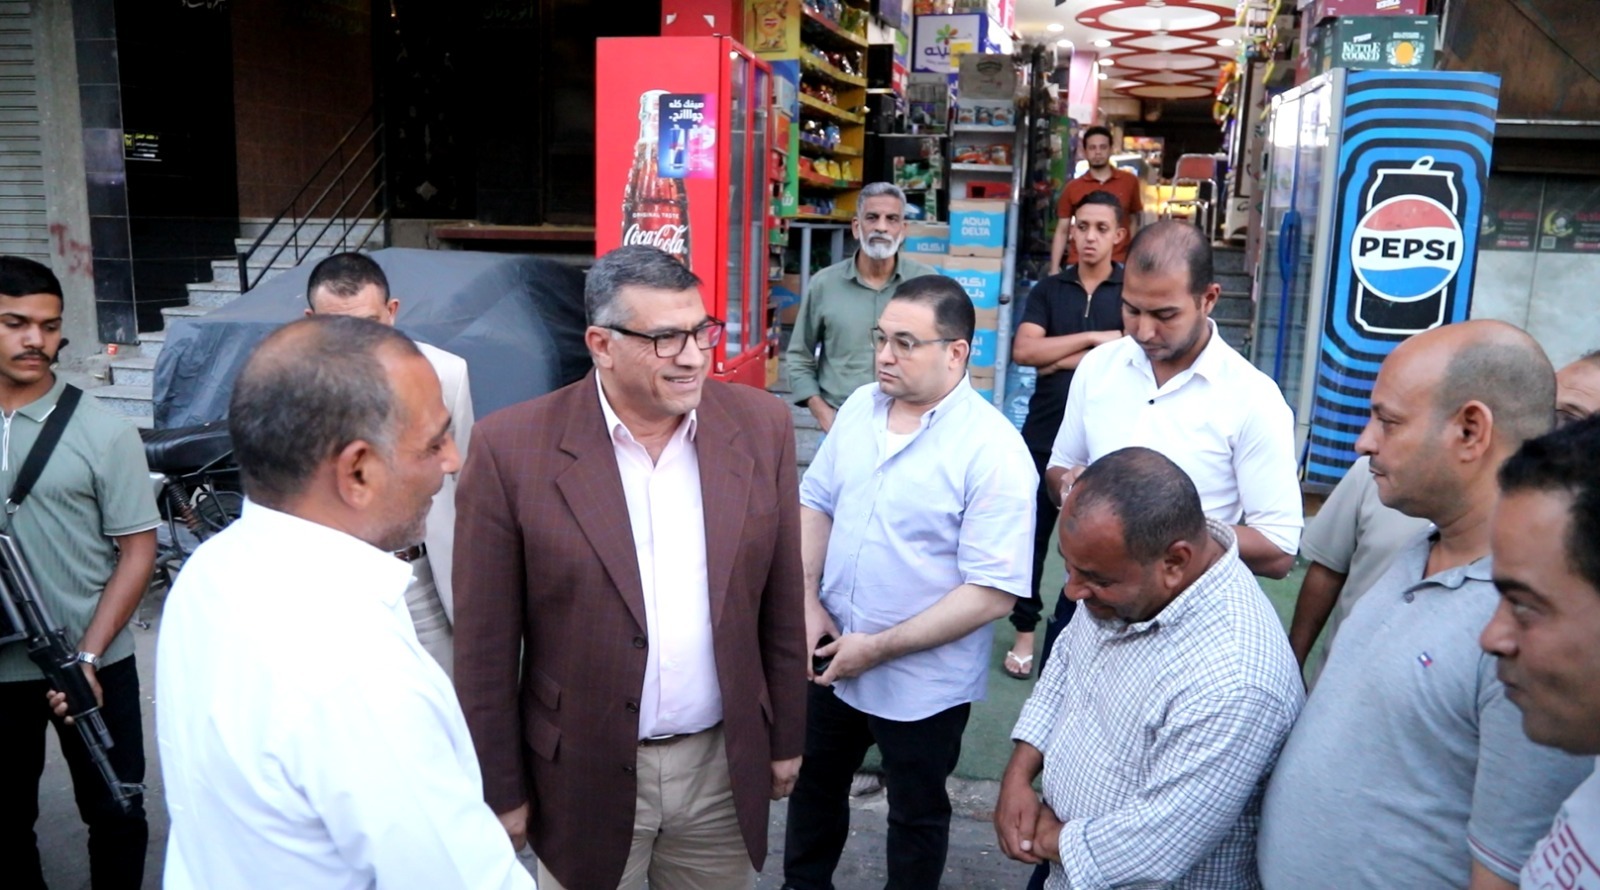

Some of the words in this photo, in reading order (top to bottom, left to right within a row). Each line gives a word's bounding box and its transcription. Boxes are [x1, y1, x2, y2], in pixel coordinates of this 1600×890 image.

[1343, 42, 1381, 54] KETTLE
[1342, 53, 1381, 63] COOKED
[668, 99, 682, 109] كله
[683, 99, 705, 110] صيفك
[962, 216, 991, 227] AQUA
[961, 226, 991, 237] DELTA
[623, 223, 689, 255] Coca-Cola
[1359, 236, 1456, 261] PEPSI
